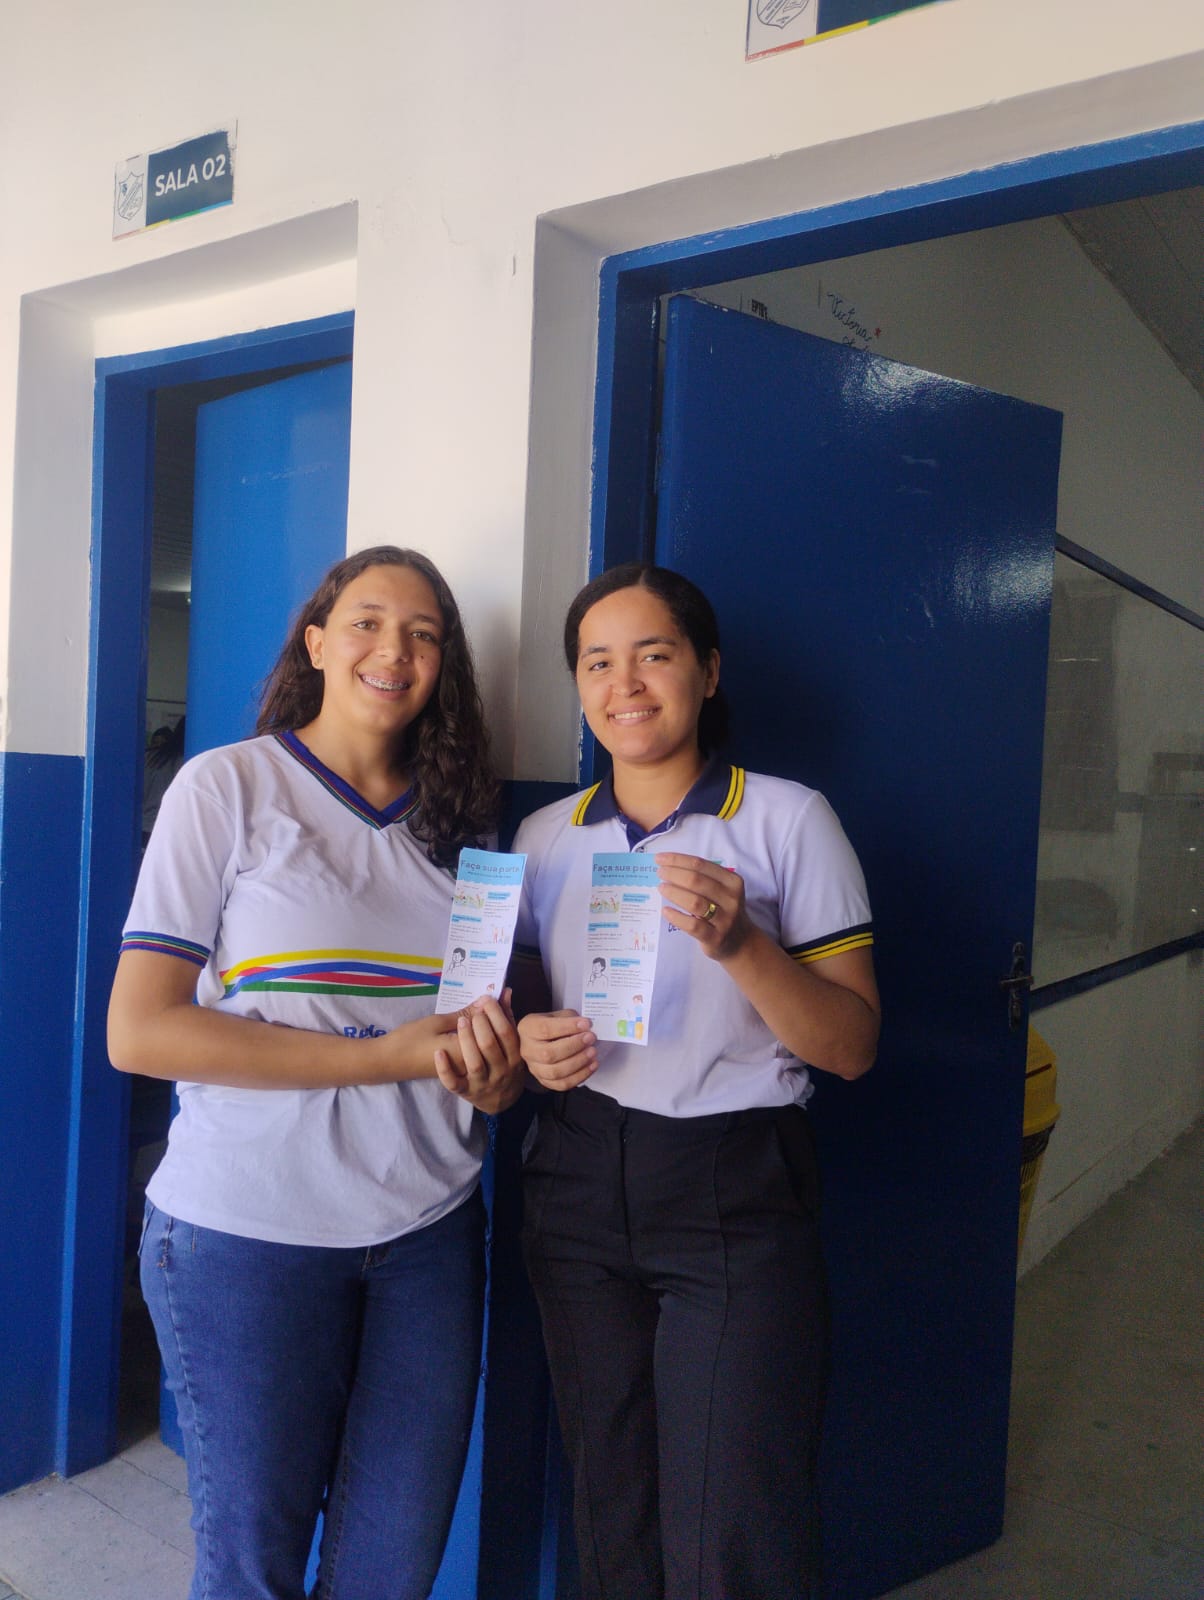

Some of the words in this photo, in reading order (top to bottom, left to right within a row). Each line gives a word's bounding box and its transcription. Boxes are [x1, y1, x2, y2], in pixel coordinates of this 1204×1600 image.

[155, 164, 198, 196] SALA
[202, 154, 226, 181] 02
[460, 860, 481, 871] Faça
[482, 864, 498, 873] sua
[592, 863, 613, 873] Faça
[614, 865, 631, 873] sua
[632, 864, 658, 874] parte
